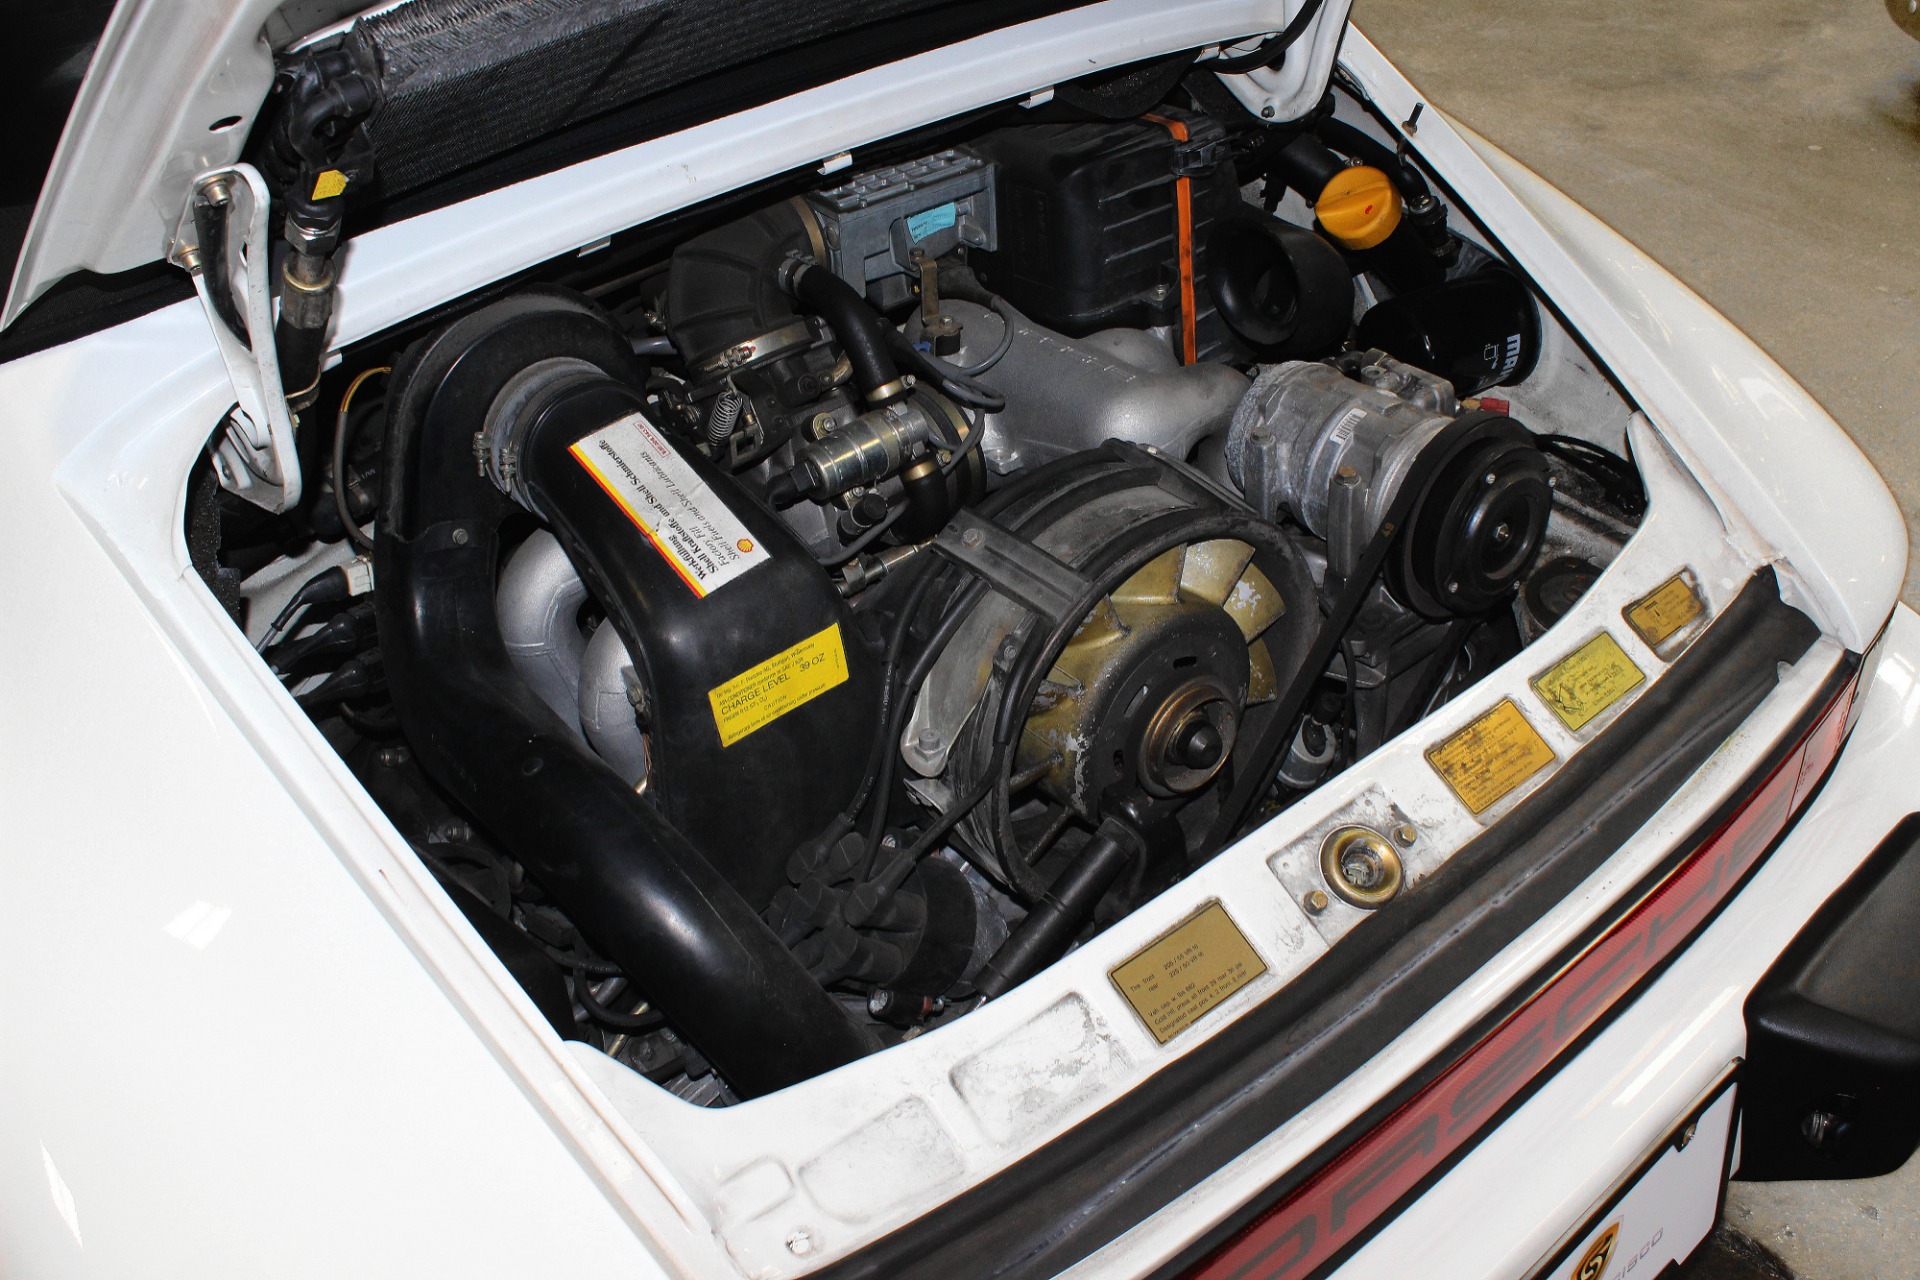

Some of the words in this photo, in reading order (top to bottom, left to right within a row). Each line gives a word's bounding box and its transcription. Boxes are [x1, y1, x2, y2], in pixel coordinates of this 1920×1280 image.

[599, 440, 641, 485] Schmierstoffe
[637, 450, 675, 488] Lubricants
[636, 484, 657, 504] Shell
[670, 488, 692, 508] Shell
[654, 503, 670, 518] und
[688, 506, 705, 522] and
[667, 517, 702, 554] Kraftstoffe
[689, 525, 705, 539] Fill
[701, 521, 723, 542] Fuels
[668, 535, 707, 580] Werkfüllung
[702, 538, 731, 566] Factory
[719, 541, 740, 560] Shell
[697, 552, 719, 573] Shell
[720, 687, 761, 716] CHARGE
[761, 670, 790, 693] LEVEL
[798, 660, 810, 673] 39
[810, 651, 825, 666] OZ
[1222, 778, 1796, 1280] ORSCHE
